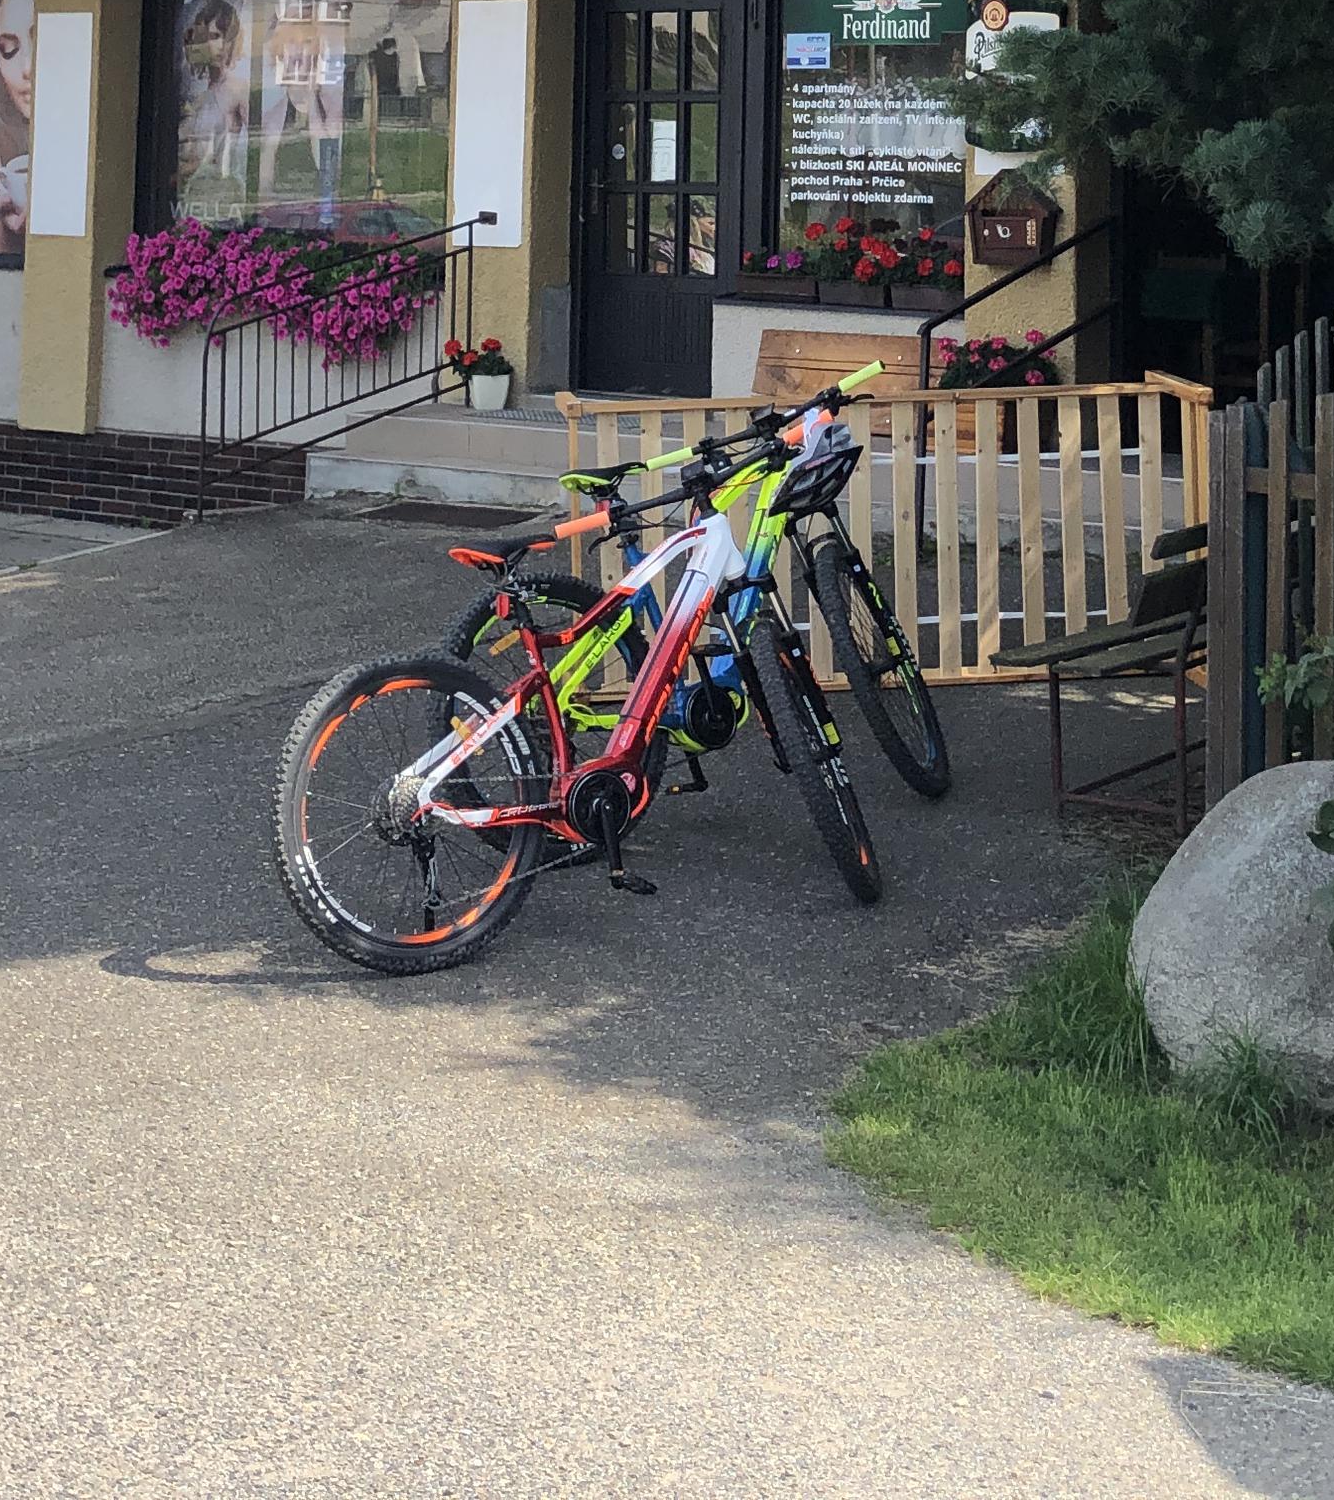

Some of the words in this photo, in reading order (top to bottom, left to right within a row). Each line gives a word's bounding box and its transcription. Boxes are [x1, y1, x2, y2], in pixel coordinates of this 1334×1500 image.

[842, 11, 931, 40] Ferdinand
[801, 83, 857, 95] apartmány
[792, 98, 835, 111] kapacita
[838, 99, 851, 109] 20
[884, 99, 902, 111] (na
[792, 114, 814, 126] WC,
[799, 159, 844, 171] blízkosti
[845, 160, 865, 171] SKI
[867, 158, 905, 172] AREÁL
[907, 158, 963, 173] MONÍNEC
[790, 174, 830, 187] pochod
[832, 175, 863, 186] Praha
[871, 176, 906, 188] Prčice
[790, 190, 841, 202] parkování
[842, 193, 850, 202] v
[851, 191, 892, 205] objektu
[893, 192, 934, 204] zdarma
[169, 201, 245, 228] WELLA
